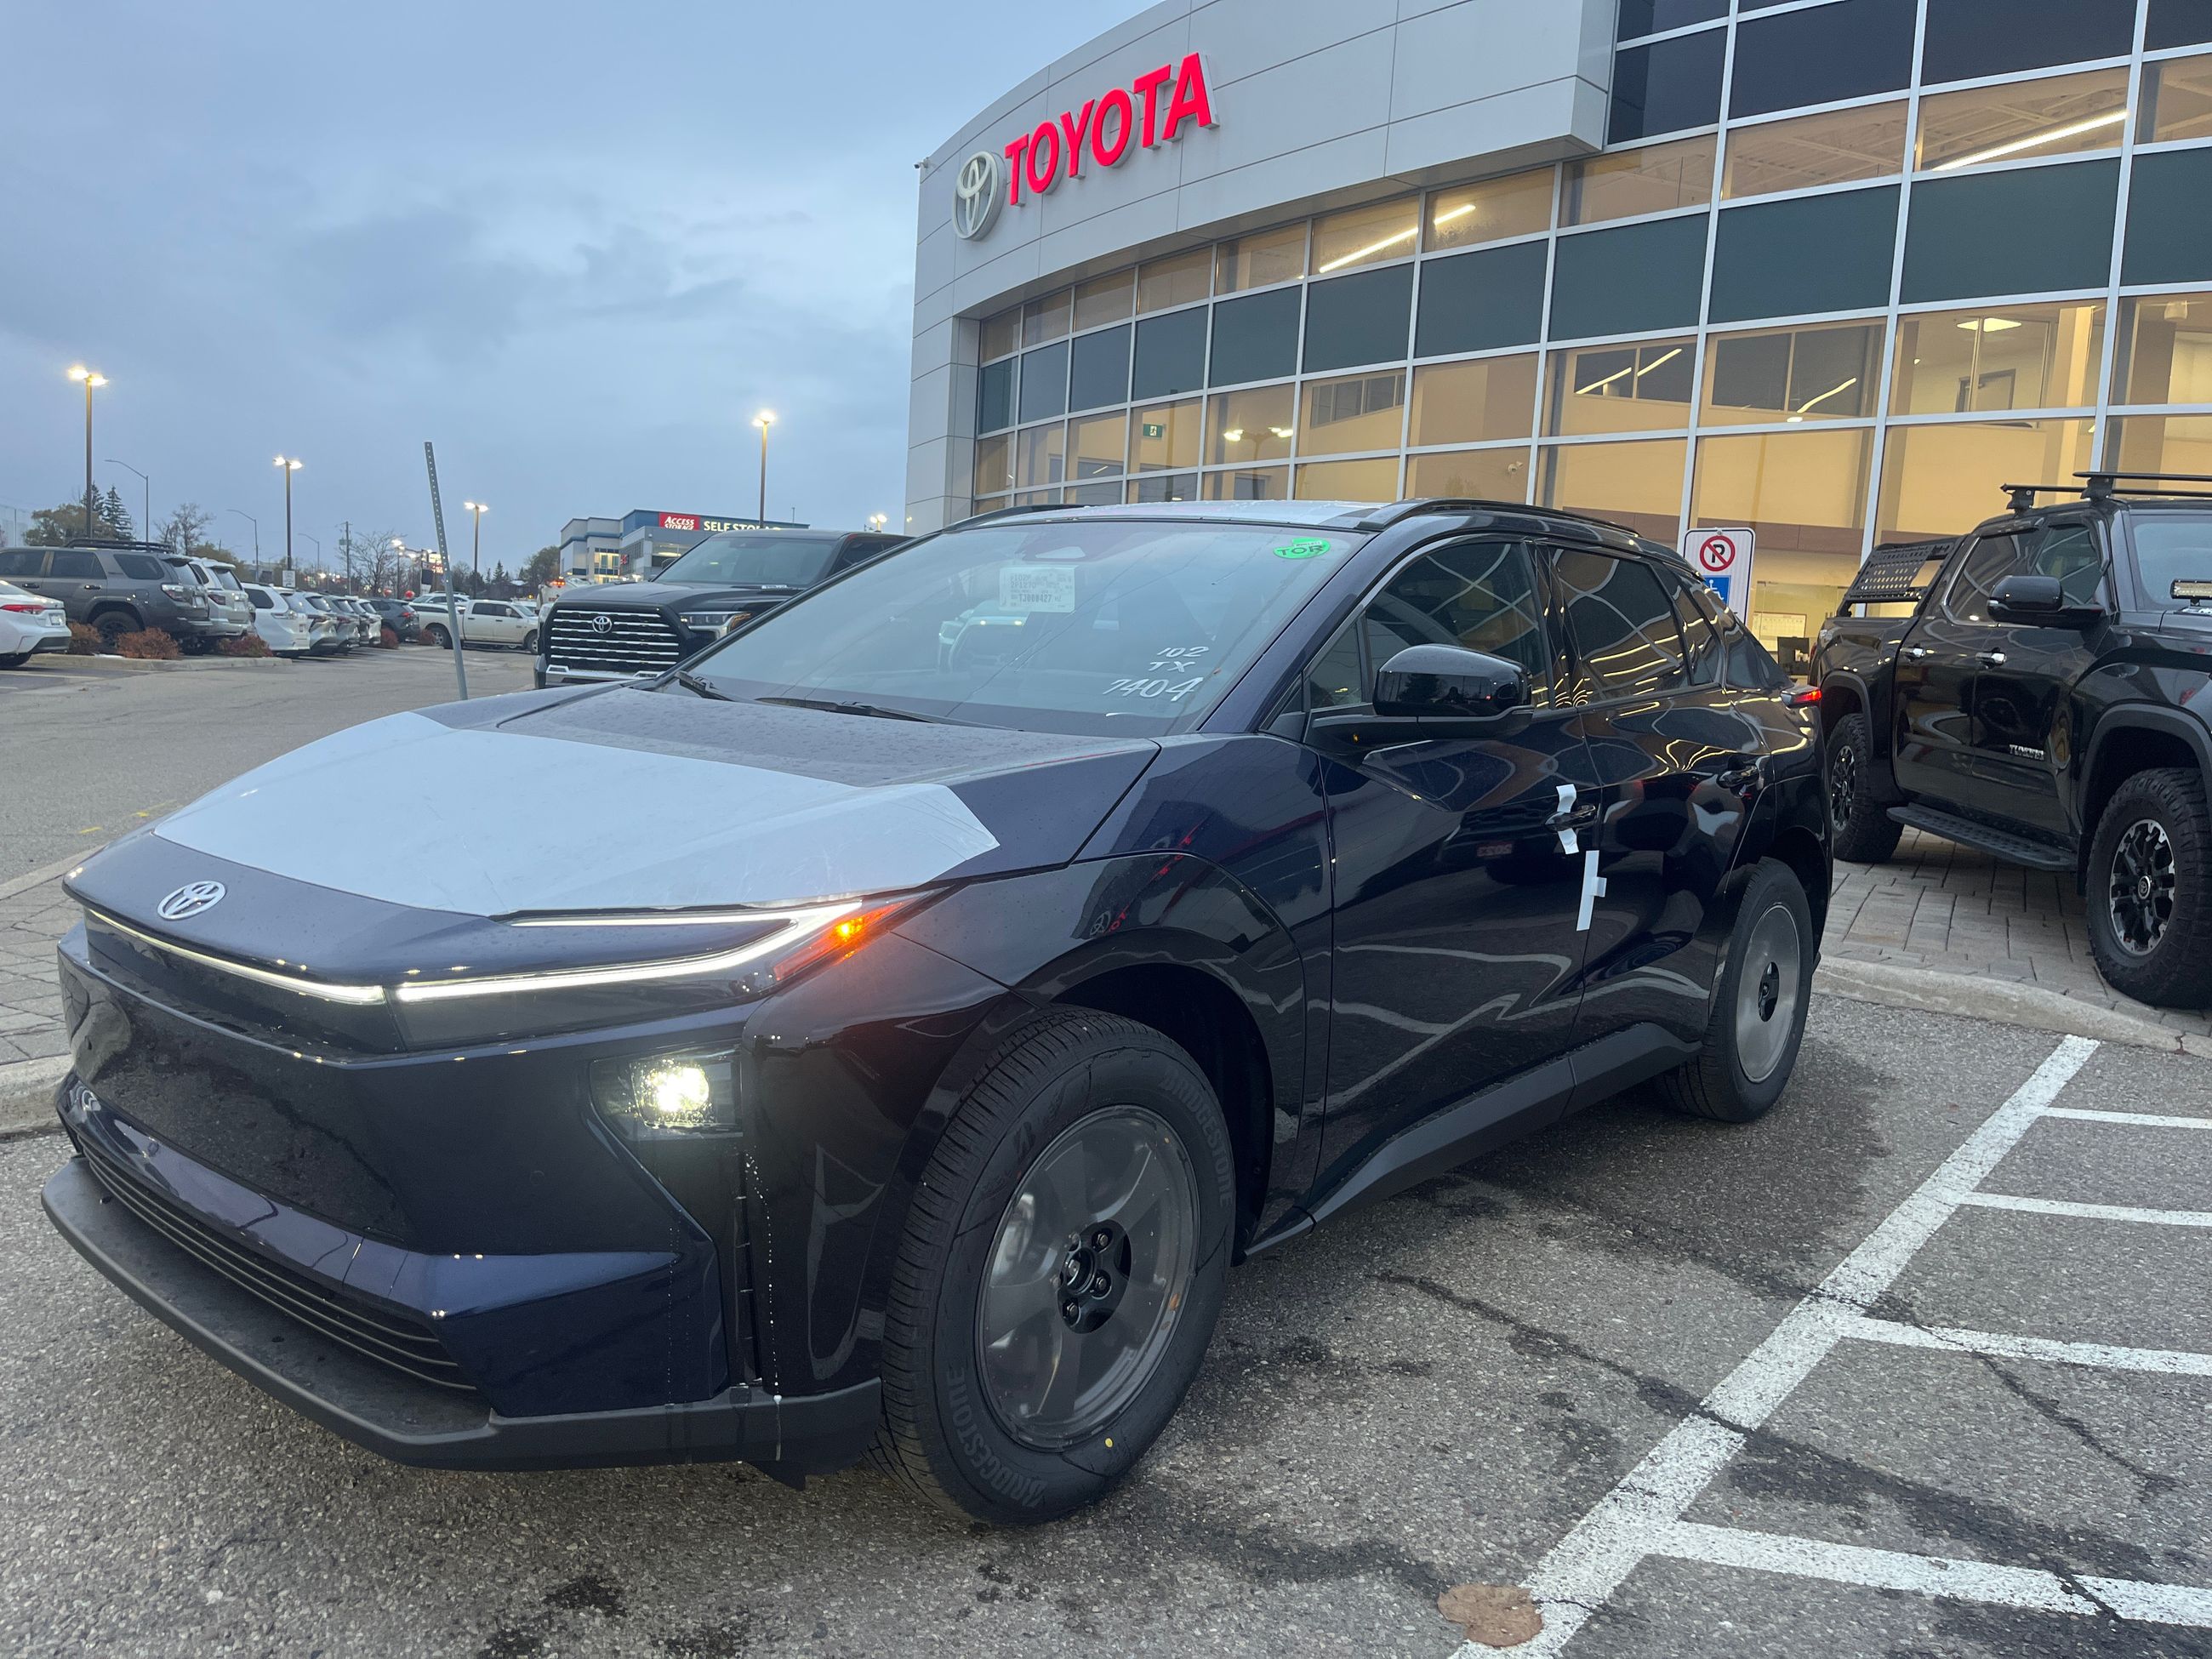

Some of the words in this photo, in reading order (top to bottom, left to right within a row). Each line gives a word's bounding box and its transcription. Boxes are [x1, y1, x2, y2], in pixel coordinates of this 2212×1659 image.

[1004, 52, 1217, 207] TOYOTA
[664, 516, 695, 526] ACCESS
[704, 521, 731, 532] SELF
[1276, 544, 1324, 556] TOR
[1156, 646, 1209, 658] 102
[946, 1366, 1048, 1508] BRIDGESTONE
